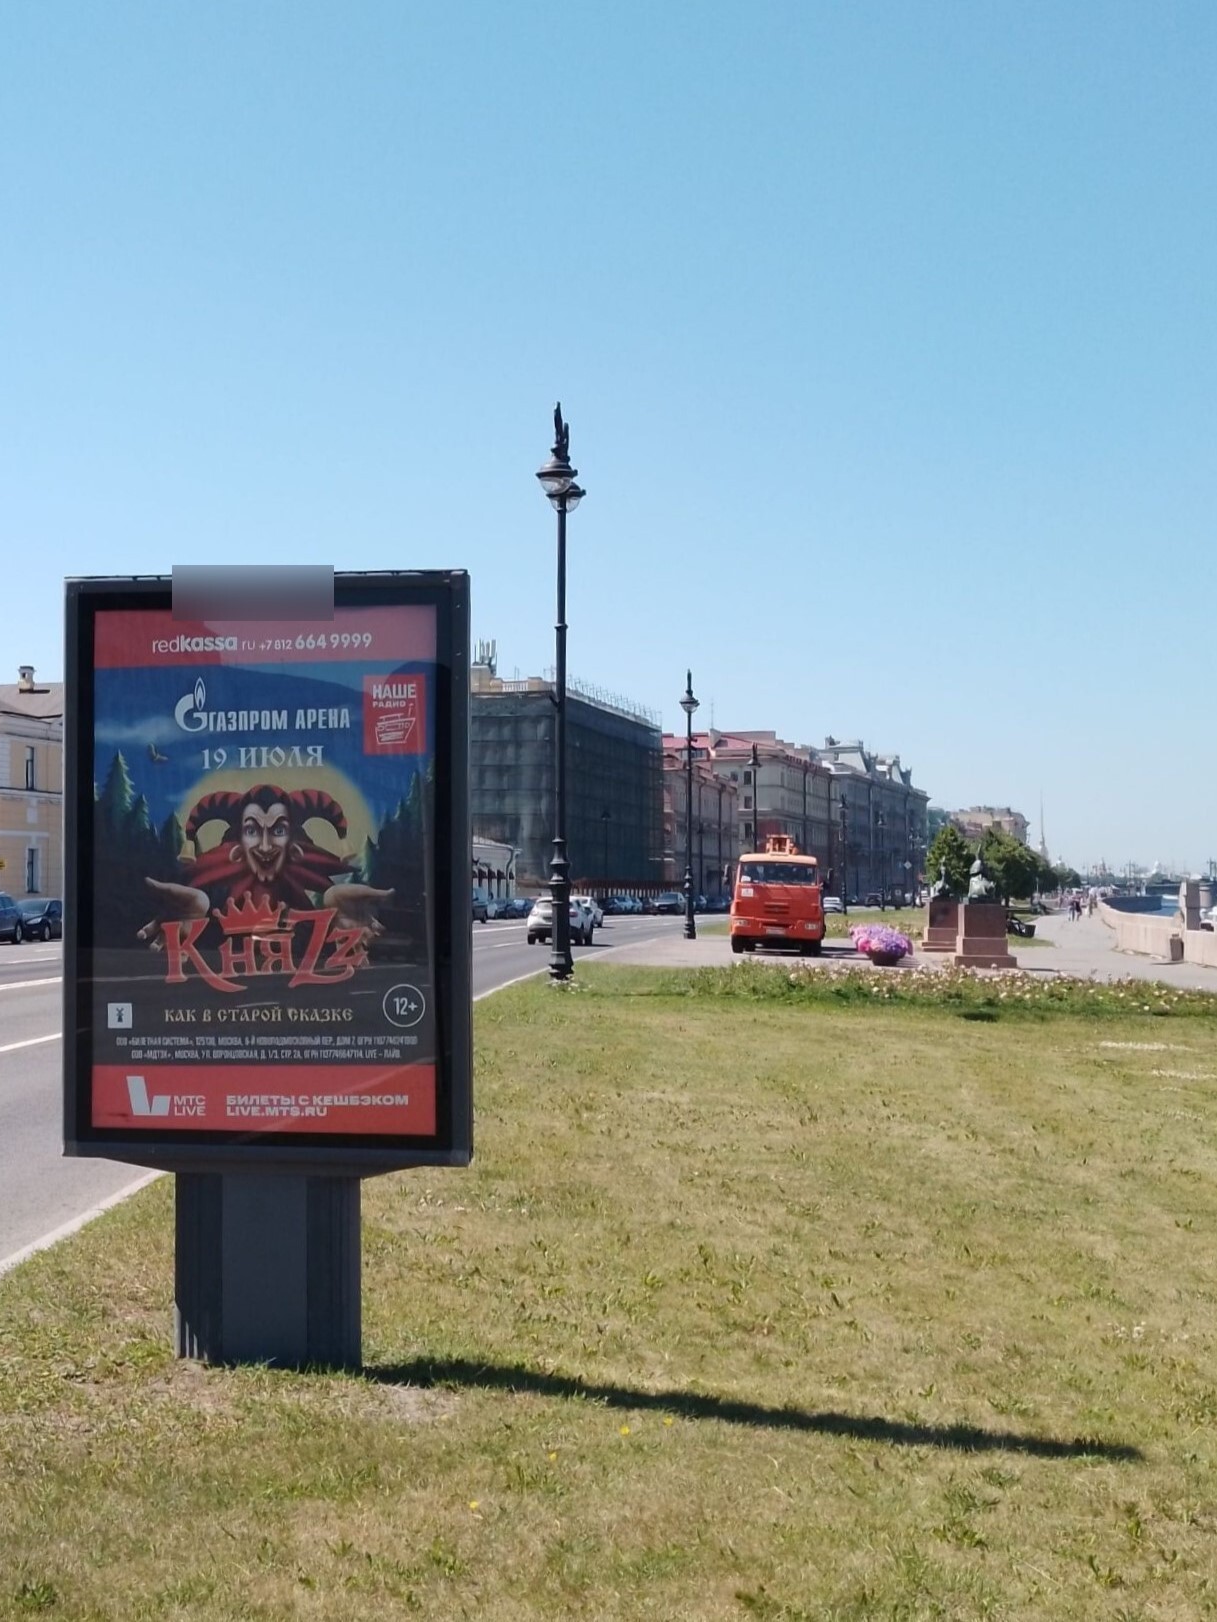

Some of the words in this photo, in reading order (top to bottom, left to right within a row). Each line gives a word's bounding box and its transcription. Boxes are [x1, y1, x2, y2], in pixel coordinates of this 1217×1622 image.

[259, 640, 273, 651] +7
[274, 639, 293, 651] 812
[295, 634, 327, 650] 664
[330, 632, 373, 649] 9999
[372, 683, 417, 700] НАШЕ
[372, 700, 407, 708] РАДИО
[208, 709, 288, 732] ГАЗПРОМ
[295, 708, 351, 730] АРЕНА
[201, 747, 228, 770] 19
[238, 745, 325, 769] ИЮЛЯ
[164, 1008, 197, 1022] КАК
[203, 1008, 212, 1022] В
[217, 1005, 283, 1023] СТАРОЙ
[287, 1007, 354, 1022] СКАЗКЕ
[393, 997, 418, 1016] 12+
[173, 1095, 206, 1106] МТС
[226, 1095, 296, 1106] БИЛЕТЫ
[298, 1095, 310, 1106] С
[312, 1095, 409, 1106] КЕШБЭКОМ
[173, 1106, 206, 1117] LIVE
[226, 1106, 328, 1117] LIVE.MTS.RU
